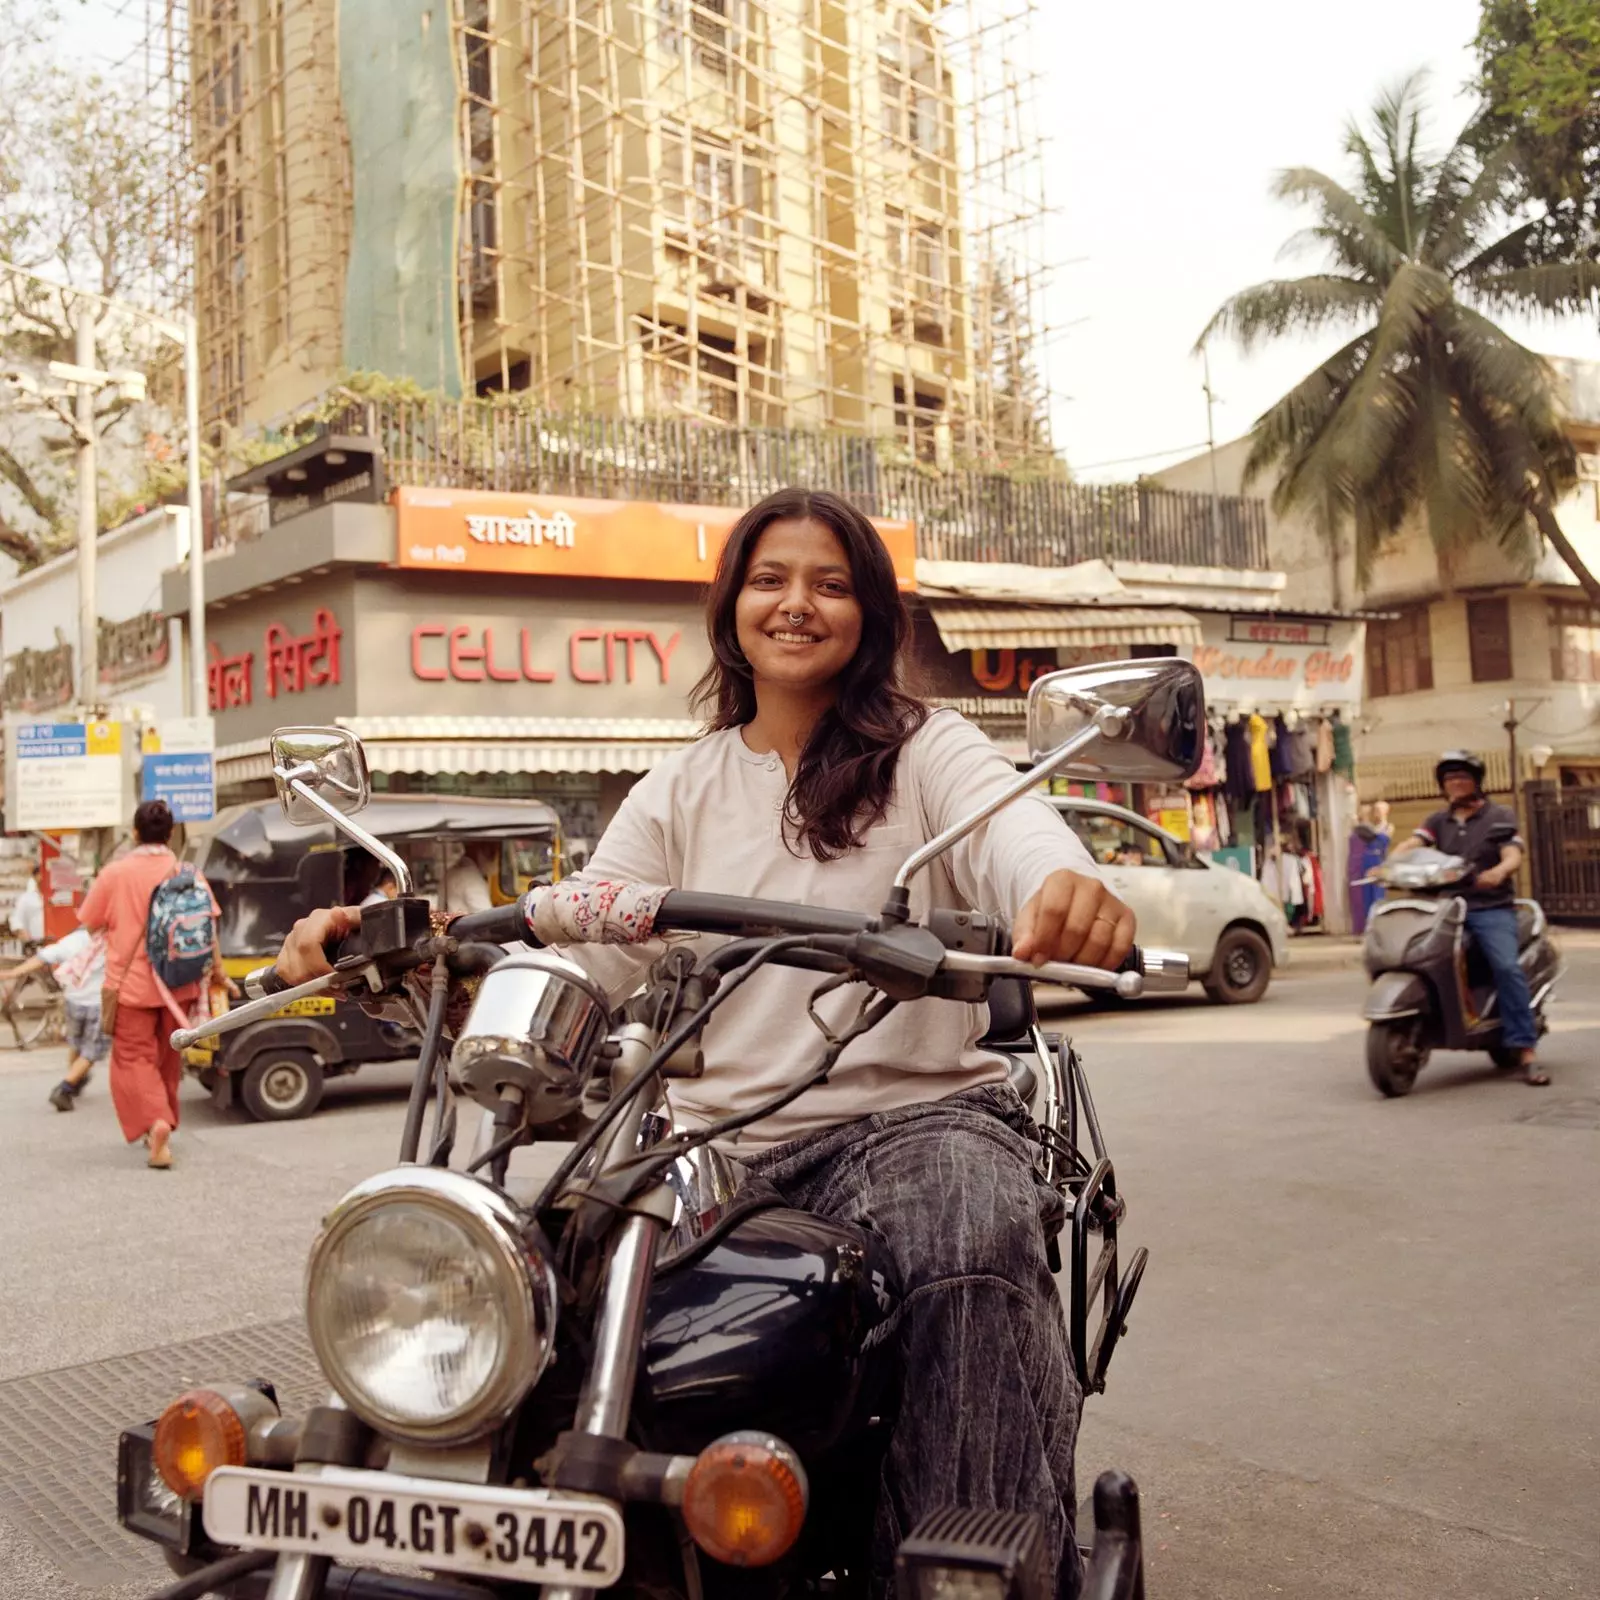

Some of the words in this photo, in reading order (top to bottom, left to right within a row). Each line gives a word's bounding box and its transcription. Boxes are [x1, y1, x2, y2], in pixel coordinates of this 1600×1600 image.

[465, 509, 576, 549] शाओमी
[265, 606, 343, 699] सिटी
[411, 623, 556, 683] CELL
[569, 628, 682, 684] CITY
